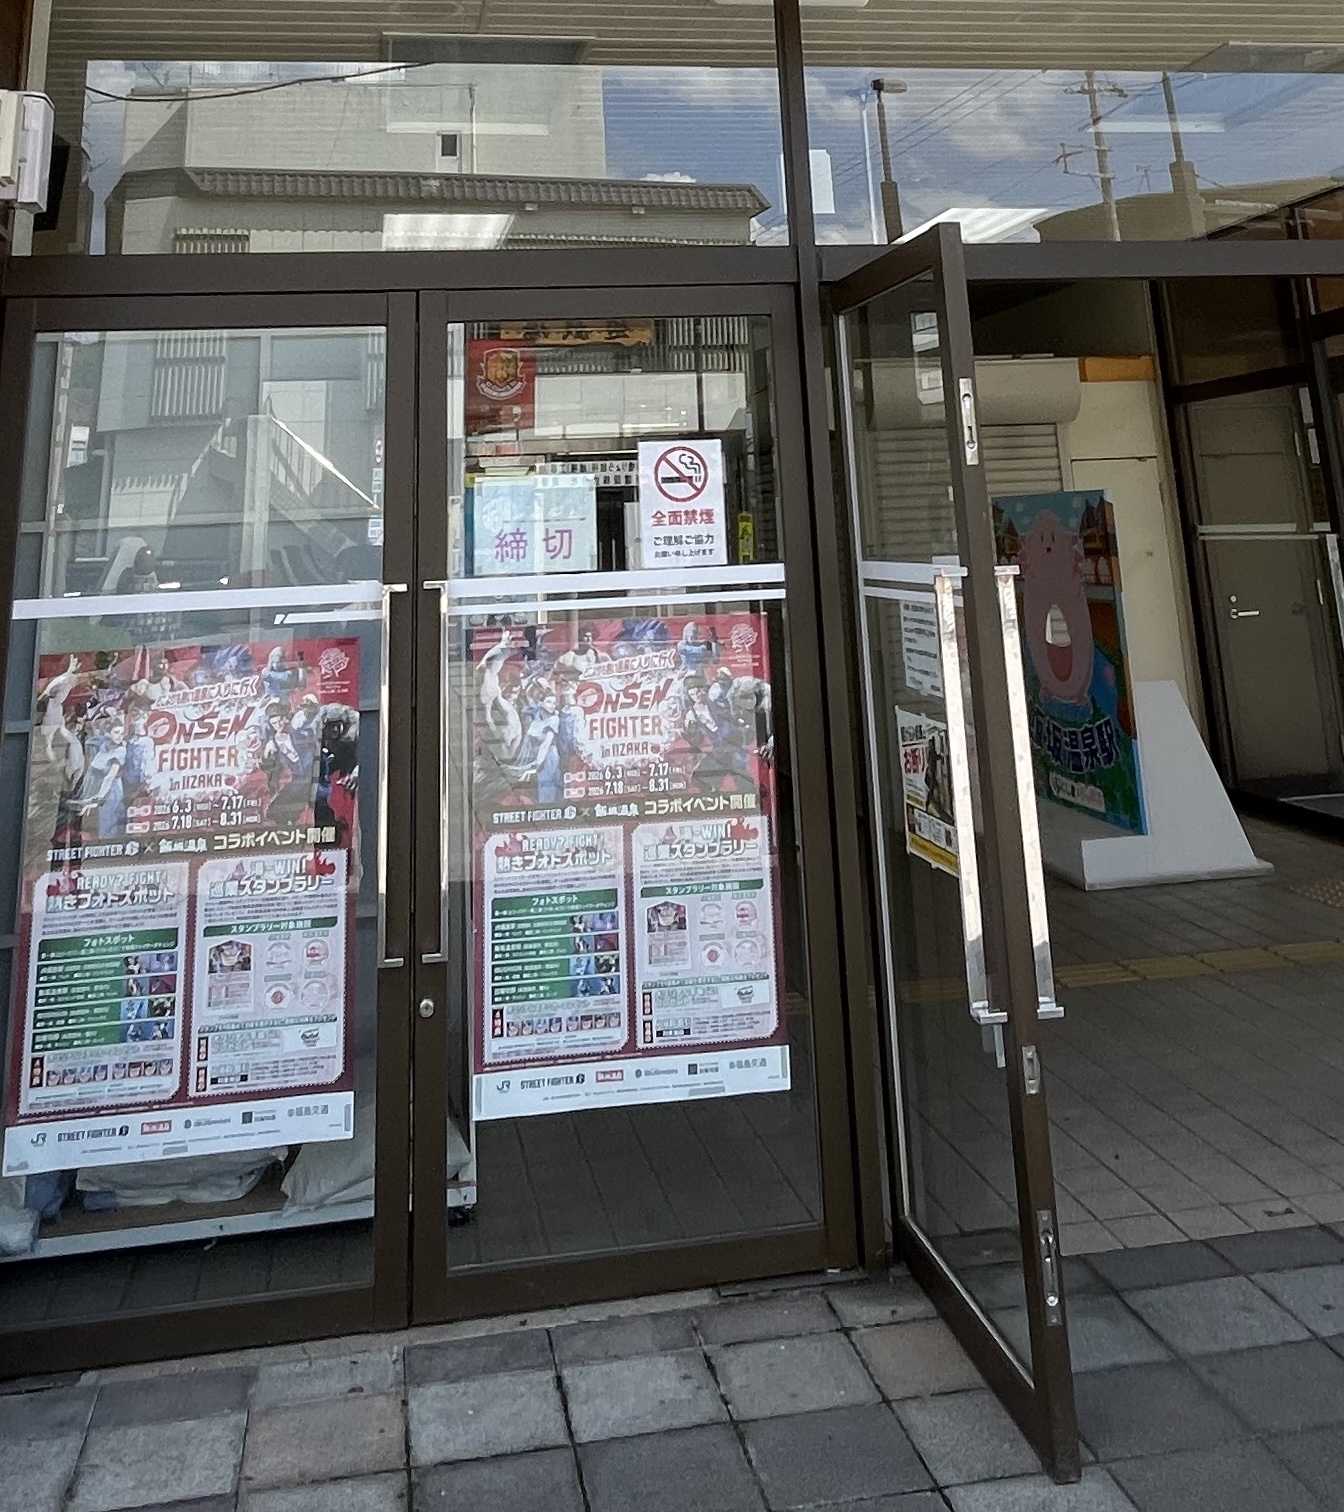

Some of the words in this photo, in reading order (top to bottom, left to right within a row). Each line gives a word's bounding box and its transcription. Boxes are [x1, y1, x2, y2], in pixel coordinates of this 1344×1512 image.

[651, 508, 715, 527] 全面禁煙
[494, 527, 573, 564] 締切
[653, 533, 715, 546] ご理解ご協力
[589, 715, 664, 741] FIGHTER
[158, 745, 239, 773] FIGHTER
[612, 741, 649, 757] IIZAKA
[182, 773, 223, 790] IIZAKA
[493, 810, 527, 825] STREET
[527, 809, 562, 823] FIGHTER
[644, 794, 758, 816] コラボイベント開催
[46, 845, 83, 861] STREET
[84, 843, 123, 859] FIGHTER
[213, 826, 336, 851] コラボイベント開催
[496, 849, 612, 874] 熱きフォトスポット
[532, 894, 578, 906] フォトスポット
[84, 934, 135, 947] フォトスポット
